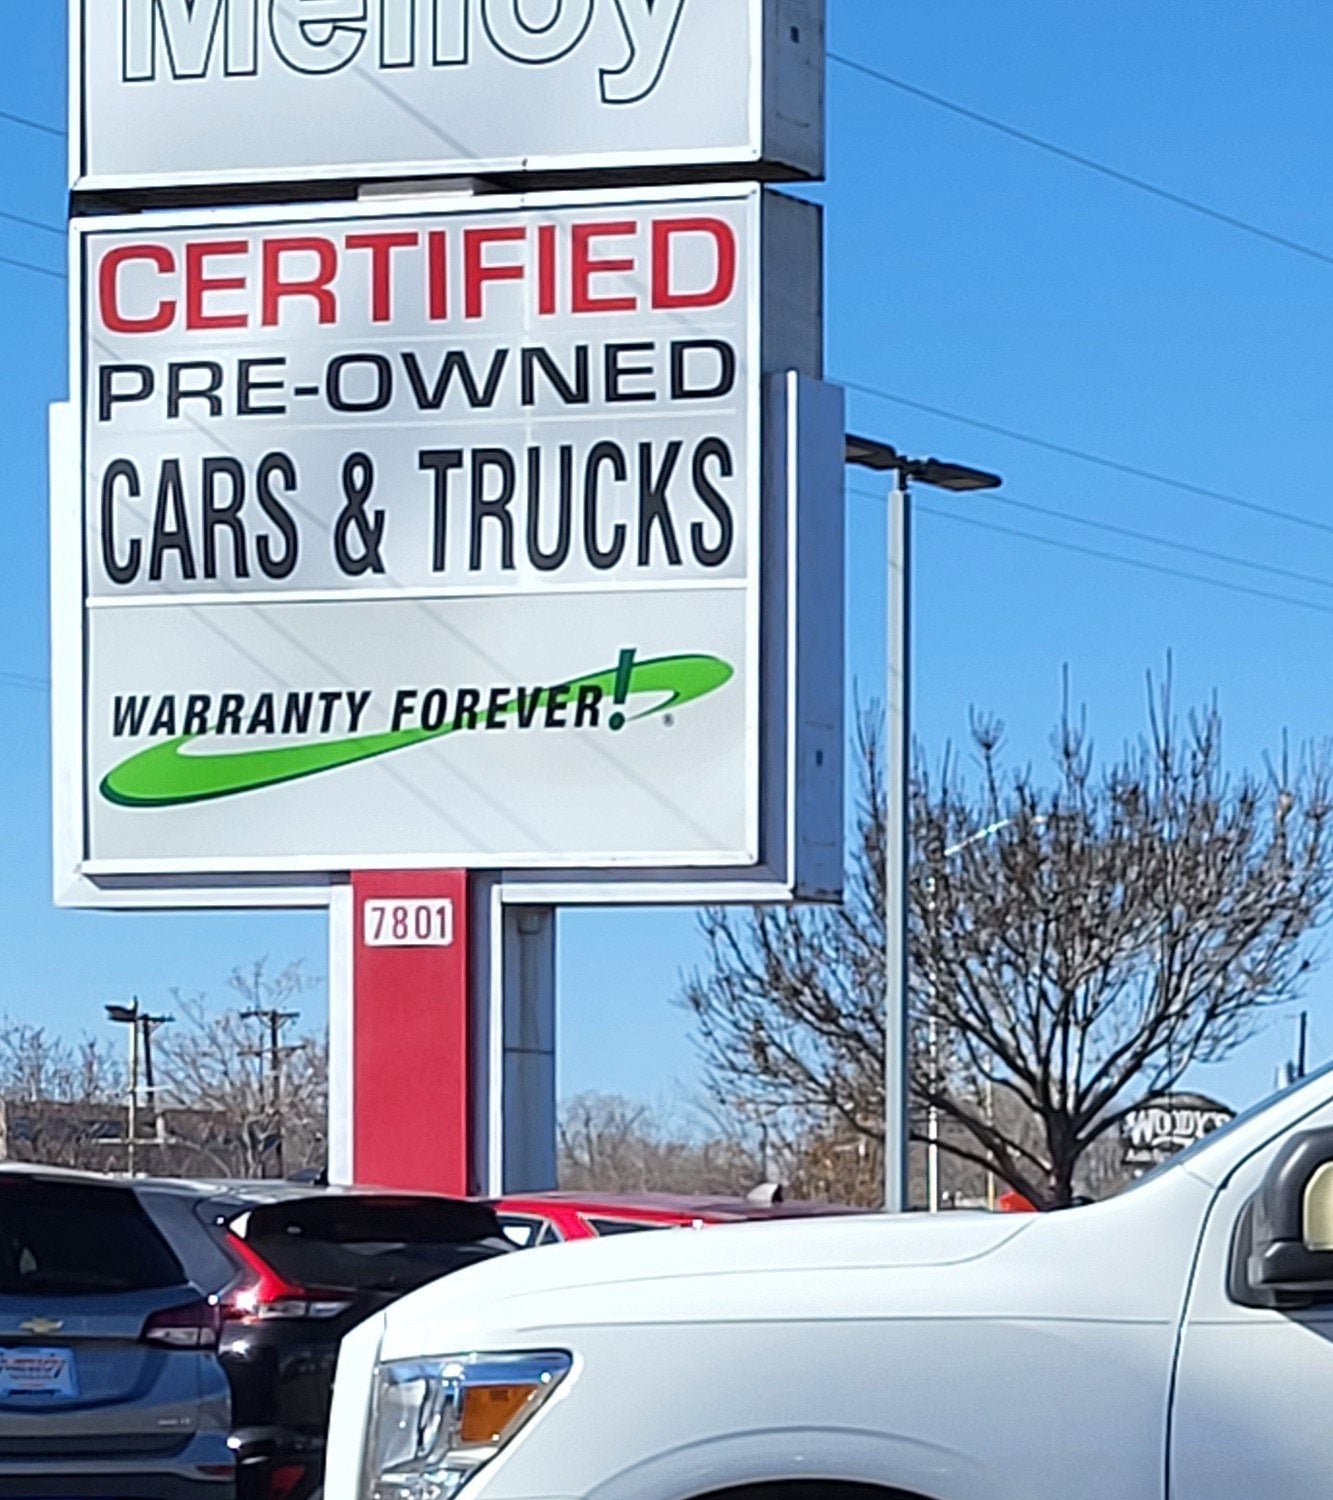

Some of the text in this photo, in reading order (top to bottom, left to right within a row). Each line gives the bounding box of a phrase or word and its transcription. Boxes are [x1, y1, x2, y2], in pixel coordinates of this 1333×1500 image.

[121, 0, 685, 104] Melloy
[97, 216, 738, 334] CERTIFIED
[97, 339, 737, 422] PRE-OWNED
[99, 437, 735, 585] CARS & TRUCKS
[111, 648, 637, 738] WARRANTY FOREVER!
[371, 904, 450, 942] 7801
